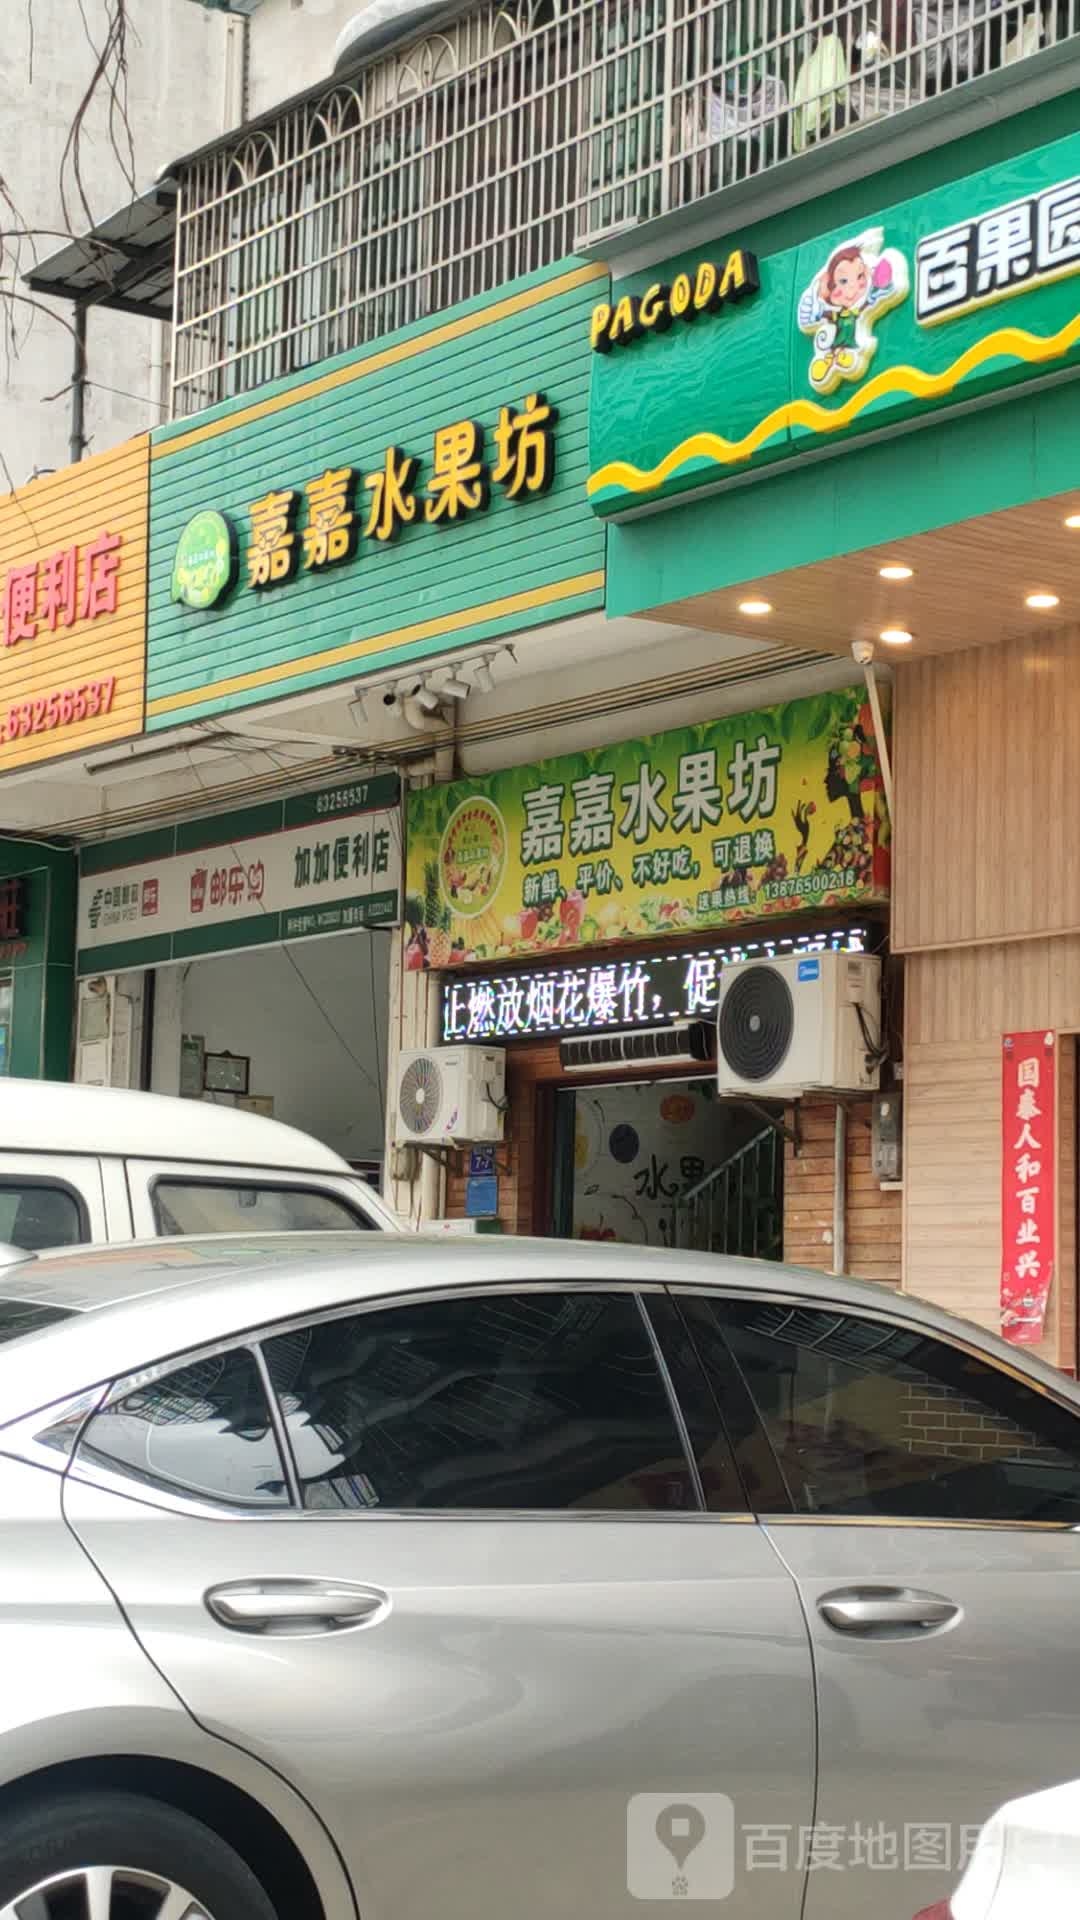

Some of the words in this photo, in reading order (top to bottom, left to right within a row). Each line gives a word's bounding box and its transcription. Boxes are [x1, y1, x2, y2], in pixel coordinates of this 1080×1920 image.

[590, 249, 747, 348] PAGODA
[247, 392, 551, 588] 嘉嘉水果坊
[3, 530, 122, 647] 便利店
[294, 828, 390, 888] 加加便利店
[521, 735, 781, 864] 嘉嘉水果坊
